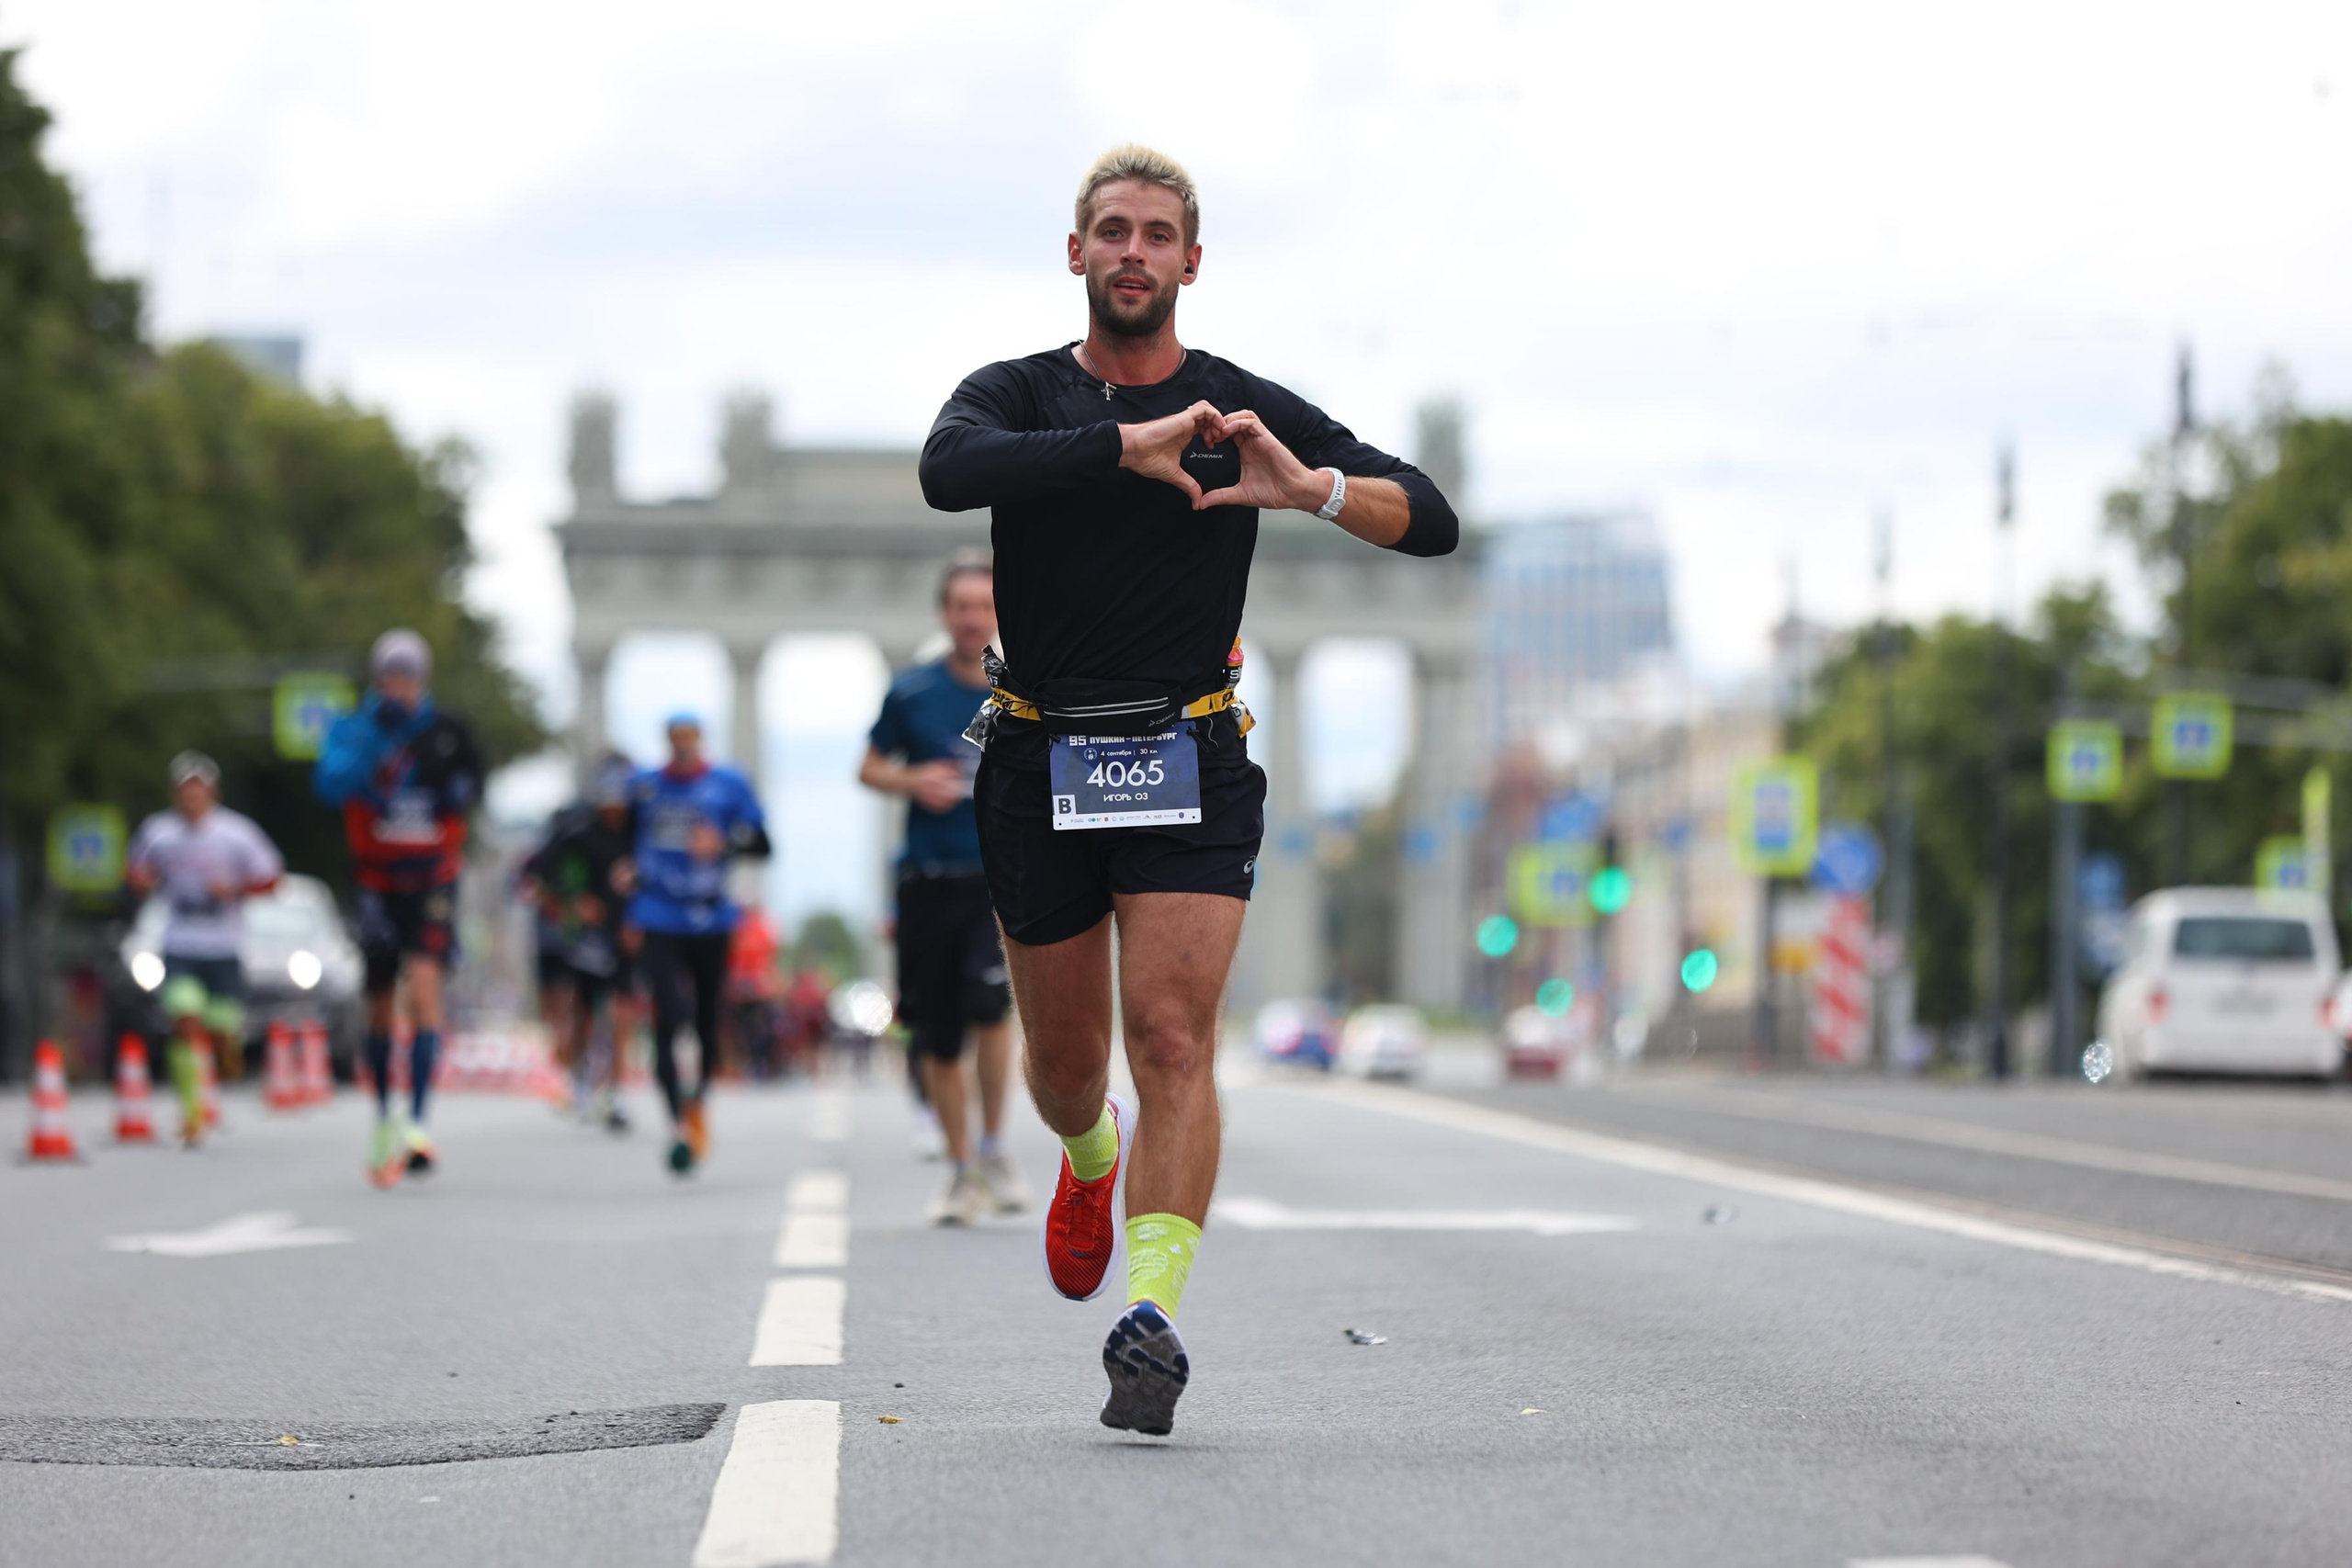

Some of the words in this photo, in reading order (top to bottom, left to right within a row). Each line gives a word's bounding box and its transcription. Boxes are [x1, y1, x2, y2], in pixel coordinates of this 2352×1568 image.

[1069, 735, 1087, 746] 95
[1090, 736, 1125, 744] ПУШКИН
[1132, 732, 1177, 742] ПЕТЕРБУРГ
[1106, 749, 1132, 757] сентября
[1086, 760, 1165, 787] 4065
[1103, 794, 1132, 802] ИГОРЬ
